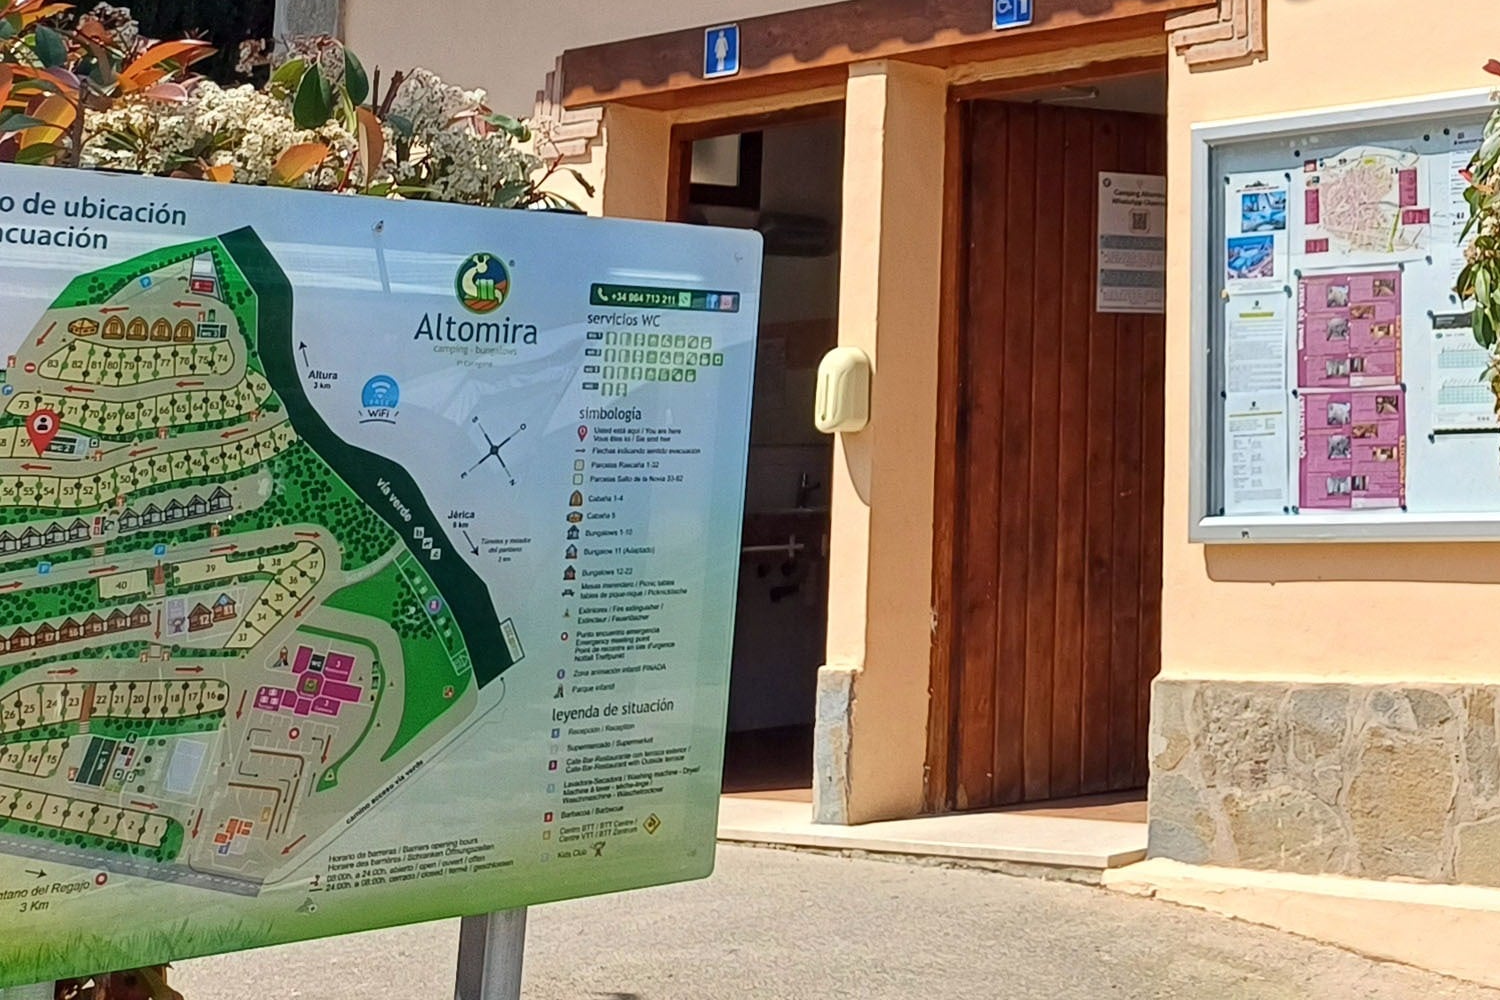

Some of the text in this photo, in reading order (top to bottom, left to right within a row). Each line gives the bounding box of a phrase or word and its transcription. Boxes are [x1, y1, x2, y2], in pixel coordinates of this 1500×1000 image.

[22, 192, 56, 216] de
[64, 196, 187, 226] ubicación
[0, 226, 108, 250] cuación
[587, 313, 661, 327] servicios WC
[413, 311, 538, 345] Altomira
[308, 370, 338, 380] Altura
[368, 409, 390, 418] WiFi
[579, 406, 642, 423] simbología
[389, 493, 413, 522] verde
[448, 510, 475, 519] Jérica
[272, 558, 281, 567] 38
[309, 560, 318, 569] 37
[206, 564, 215, 573] 39
[289, 576, 298, 585] 36
[115, 581, 127, 590] 40
[274, 593, 283, 602] 35
[257, 613, 266, 622] 34
[238, 634, 247, 642] 33
[96, 696, 107, 704] 22
[115, 695, 124, 703] 21
[133, 695, 143, 704] 20
[153, 695, 163, 703] 19
[171, 694, 180, 703] 18
[188, 692, 197, 701] 17
[206, 691, 216, 700] 16
[46, 700, 57, 709] 24
[69, 698, 79, 707] 23
[24, 704, 35, 713] 25
[552, 698, 674, 723] leyenda de situación
[4, 710, 15, 719] 26
[31, 884, 49, 896] del
[51, 880, 90, 895] Regajo
[19, 901, 49, 912] 3 Km
